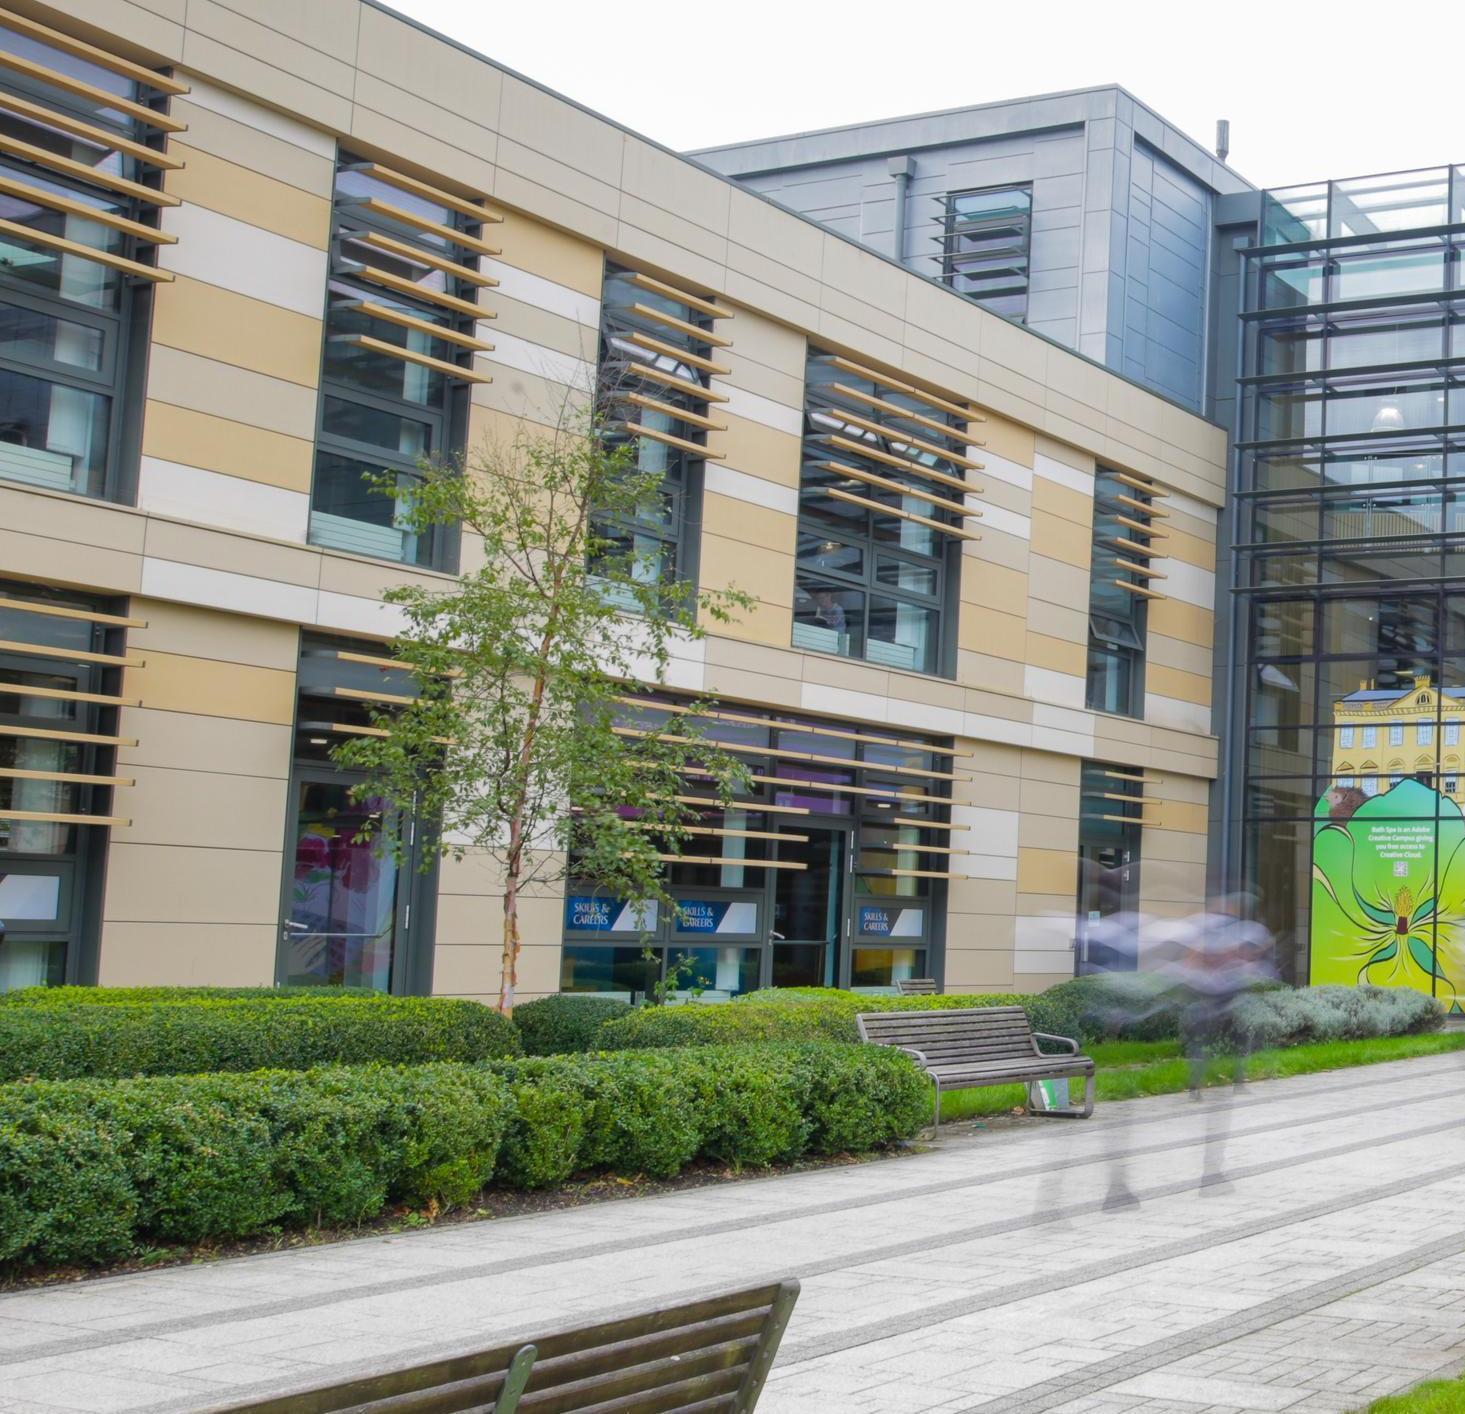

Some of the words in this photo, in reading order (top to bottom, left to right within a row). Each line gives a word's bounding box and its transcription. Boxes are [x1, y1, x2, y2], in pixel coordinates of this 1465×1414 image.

[1392, 834, 1415, 843] Campus
[574, 902, 599, 913] SKILLS
[601, 902, 610, 913] &
[683, 906, 706, 916] SKILLS
[707, 907, 714, 917] &
[572, 914, 609, 925] CAREERS
[864, 912, 882, 920] SKILLS
[883, 912, 889, 921] &
[682, 917, 714, 928] CAREERS
[864, 922, 889, 931] CAREERS
